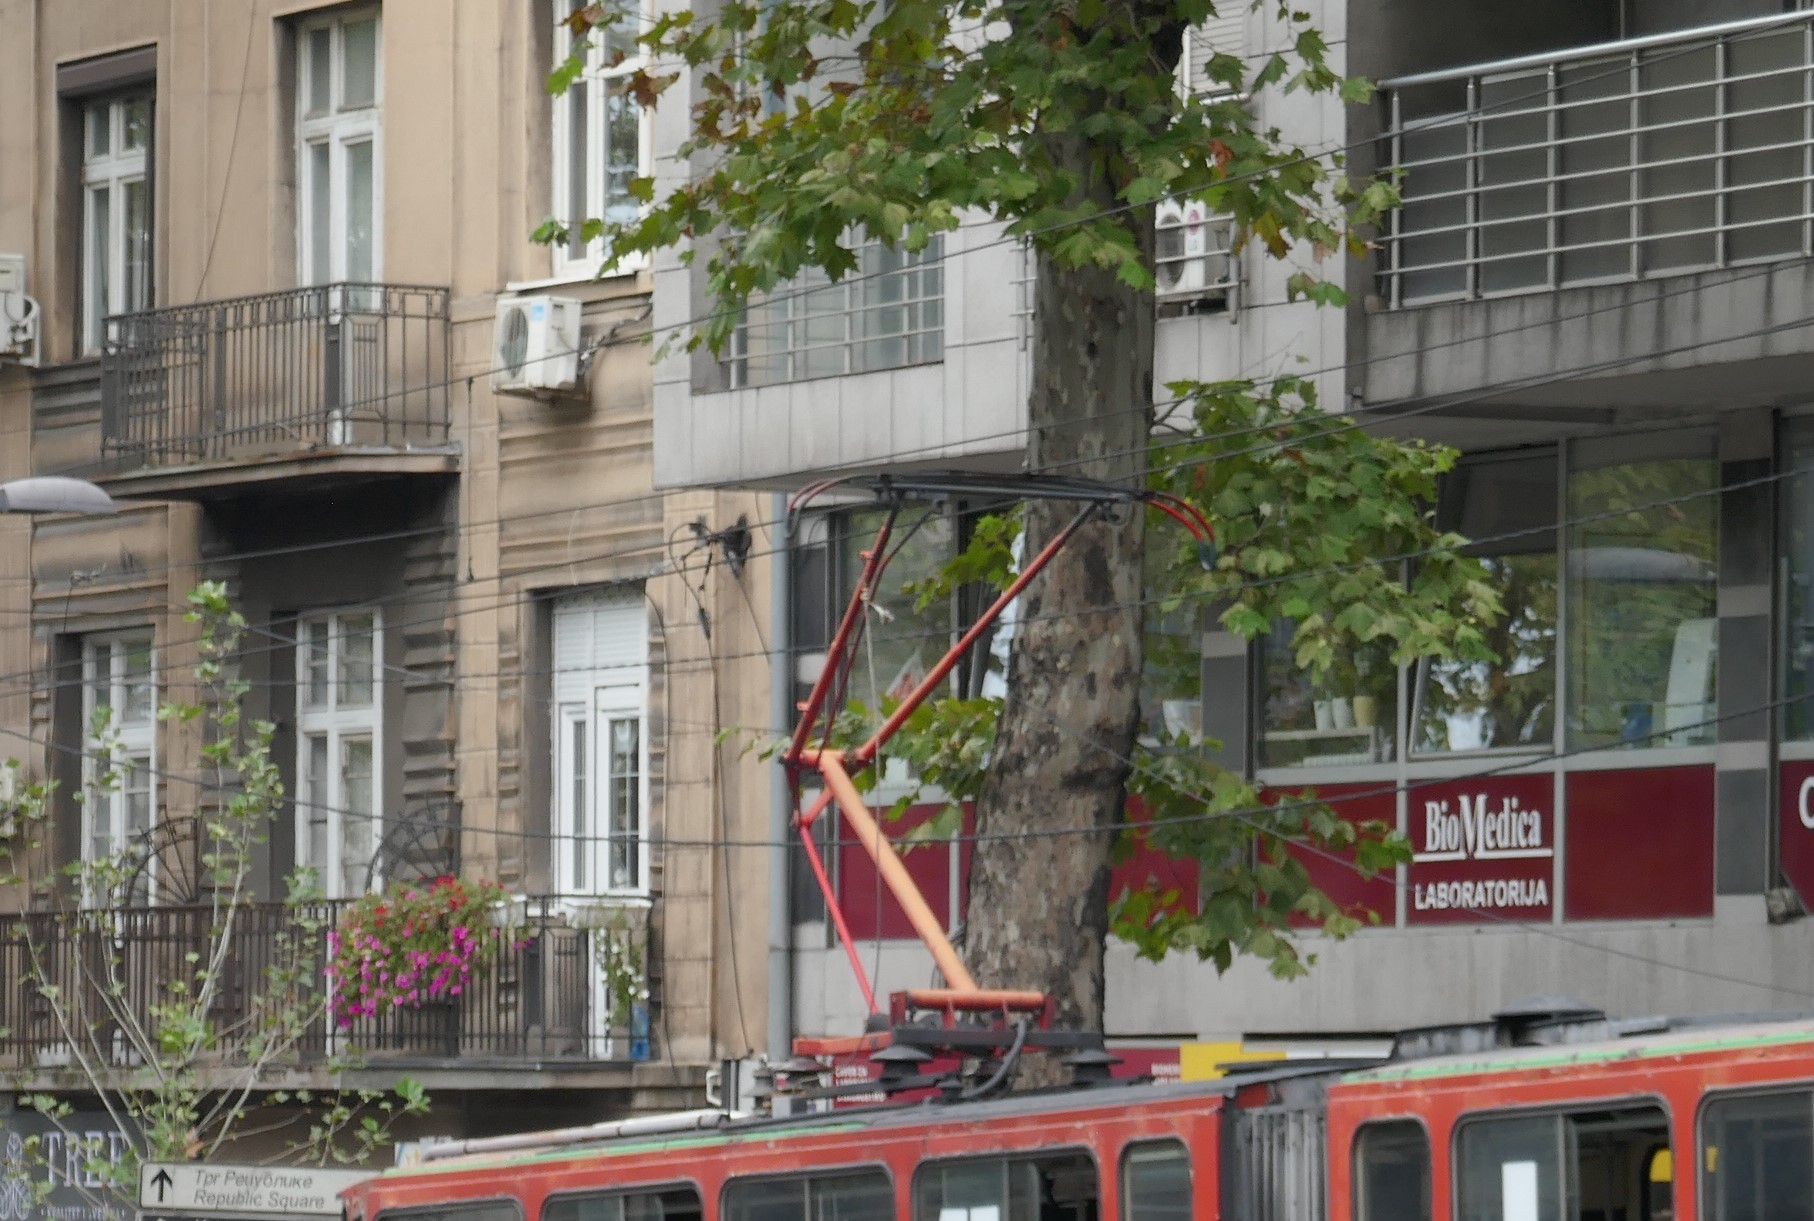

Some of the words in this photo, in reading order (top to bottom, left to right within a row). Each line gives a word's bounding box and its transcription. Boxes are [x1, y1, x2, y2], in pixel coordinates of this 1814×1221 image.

[1424, 793, 1543, 860] BioMedica
[1414, 878, 1549, 910] LABORATORIJA
[194, 1189, 263, 1210] Republic
[268, 1192, 325, 1212] Square
